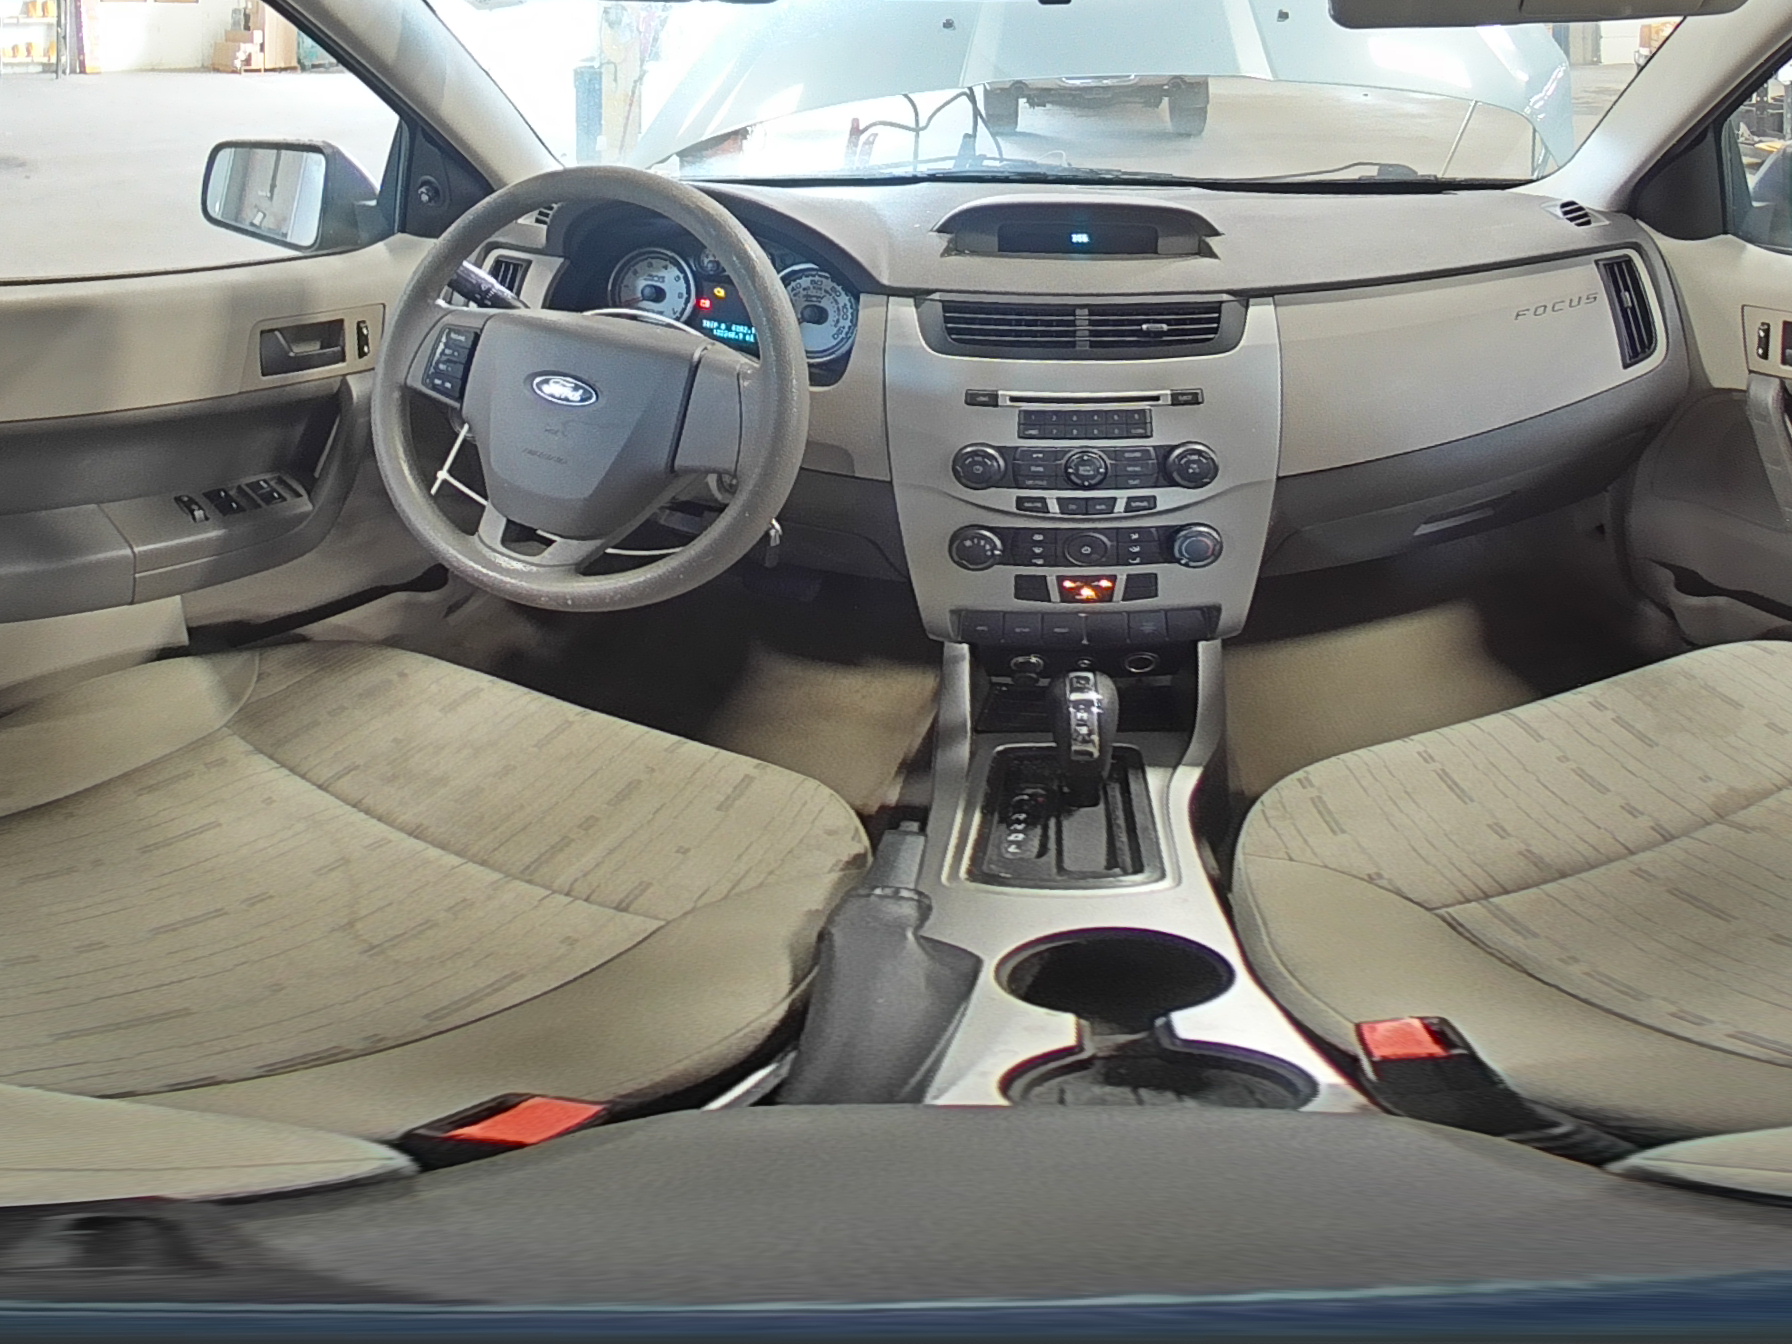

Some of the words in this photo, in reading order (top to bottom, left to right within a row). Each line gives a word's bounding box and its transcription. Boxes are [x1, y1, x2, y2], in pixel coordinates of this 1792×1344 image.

[790, 282, 802, 294] 40
[1513, 291, 1600, 321] FOCUS
[541, 378, 584, 402] Ford
